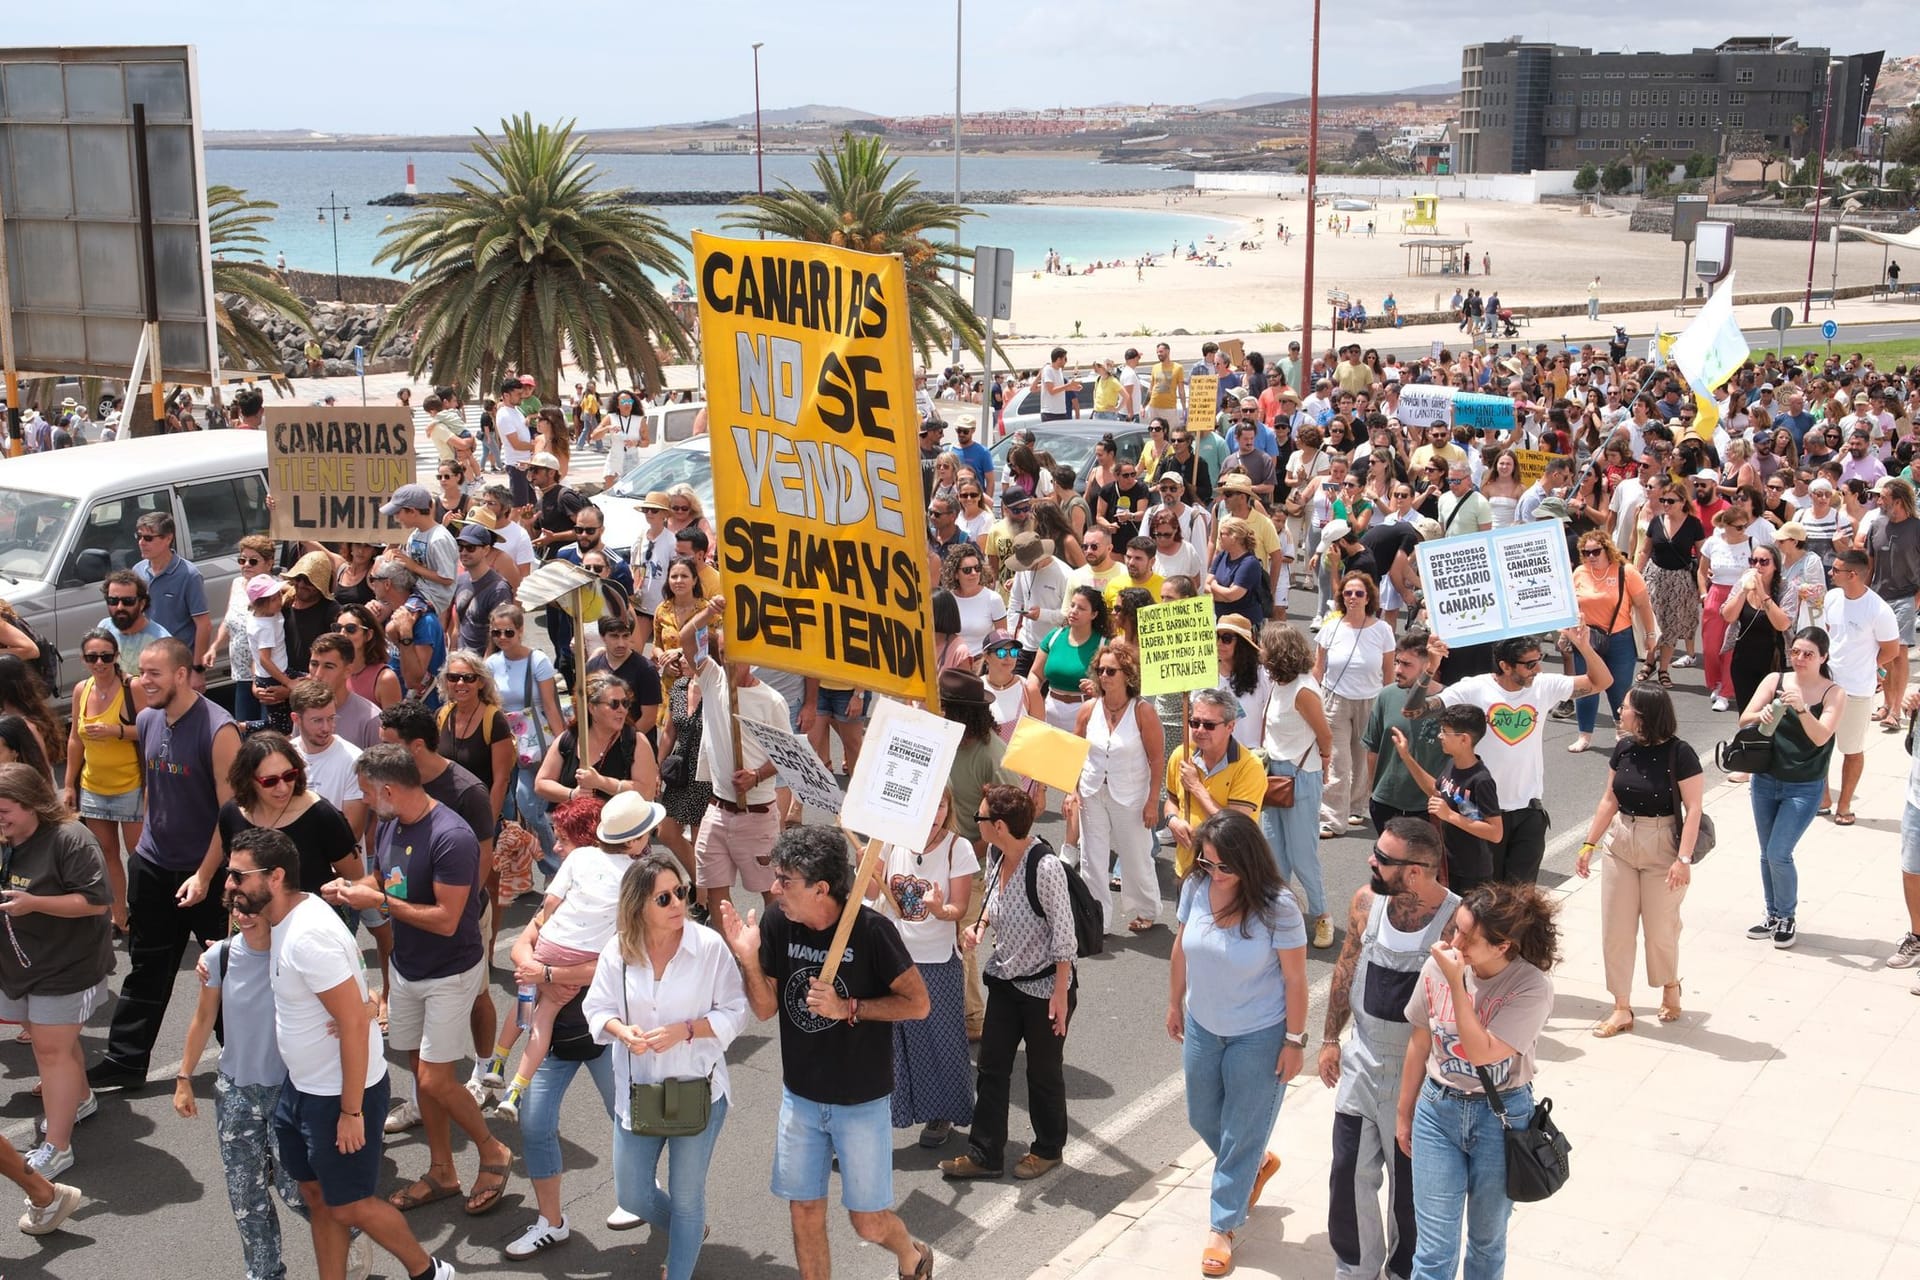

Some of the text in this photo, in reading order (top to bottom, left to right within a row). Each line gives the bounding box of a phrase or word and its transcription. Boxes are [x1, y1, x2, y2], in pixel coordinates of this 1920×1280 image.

[702, 251, 888, 339] CANARIAS
[735, 331, 896, 443] NO SE
[274, 421, 408, 455] CANARIAS
[275, 456, 409, 493] TIENE UN
[730, 425, 906, 537] VENDE
[723, 516, 779, 580] SE
[782, 528, 865, 600] AMA
[861, 542, 889, 606] Y
[1430, 546, 1485, 562] OTRO MODELO
[1431, 553, 1487, 569] DE TURISMO
[1506, 556, 1550, 571] CANARIAS:
[1432, 568, 1444, 577] ES
[1434, 570, 1491, 591] NECESARIO
[1509, 565, 1552, 580] 14MILLONES
[1458, 587, 1471, 596] EN
[1173, 604, 1190, 616] MADRE
[1193, 602, 1203, 613] ME
[1438, 592, 1496, 615] CANARIAS
[1139, 616, 1210, 635] DEJE EL BARRANCO Y LA
[1141, 635, 1165, 648] LADERA
[1166, 634, 1173, 645] YO
[1175, 632, 1183, 644] NO
[1184, 632, 1190, 642] SE
[1199, 630, 1213, 641] VENDO
[1146, 651, 1152, 664] A
[1153, 649, 1170, 662] NADIE
[1176, 646, 1195, 658] MENOS
[1198, 645, 1203, 657] A
[1204, 644, 1214, 656] UNA
[1160, 659, 1207, 679] EXTRANJERA
[889, 744, 931, 763] EXTINGUEN
[769, 753, 816, 777] COSTA
